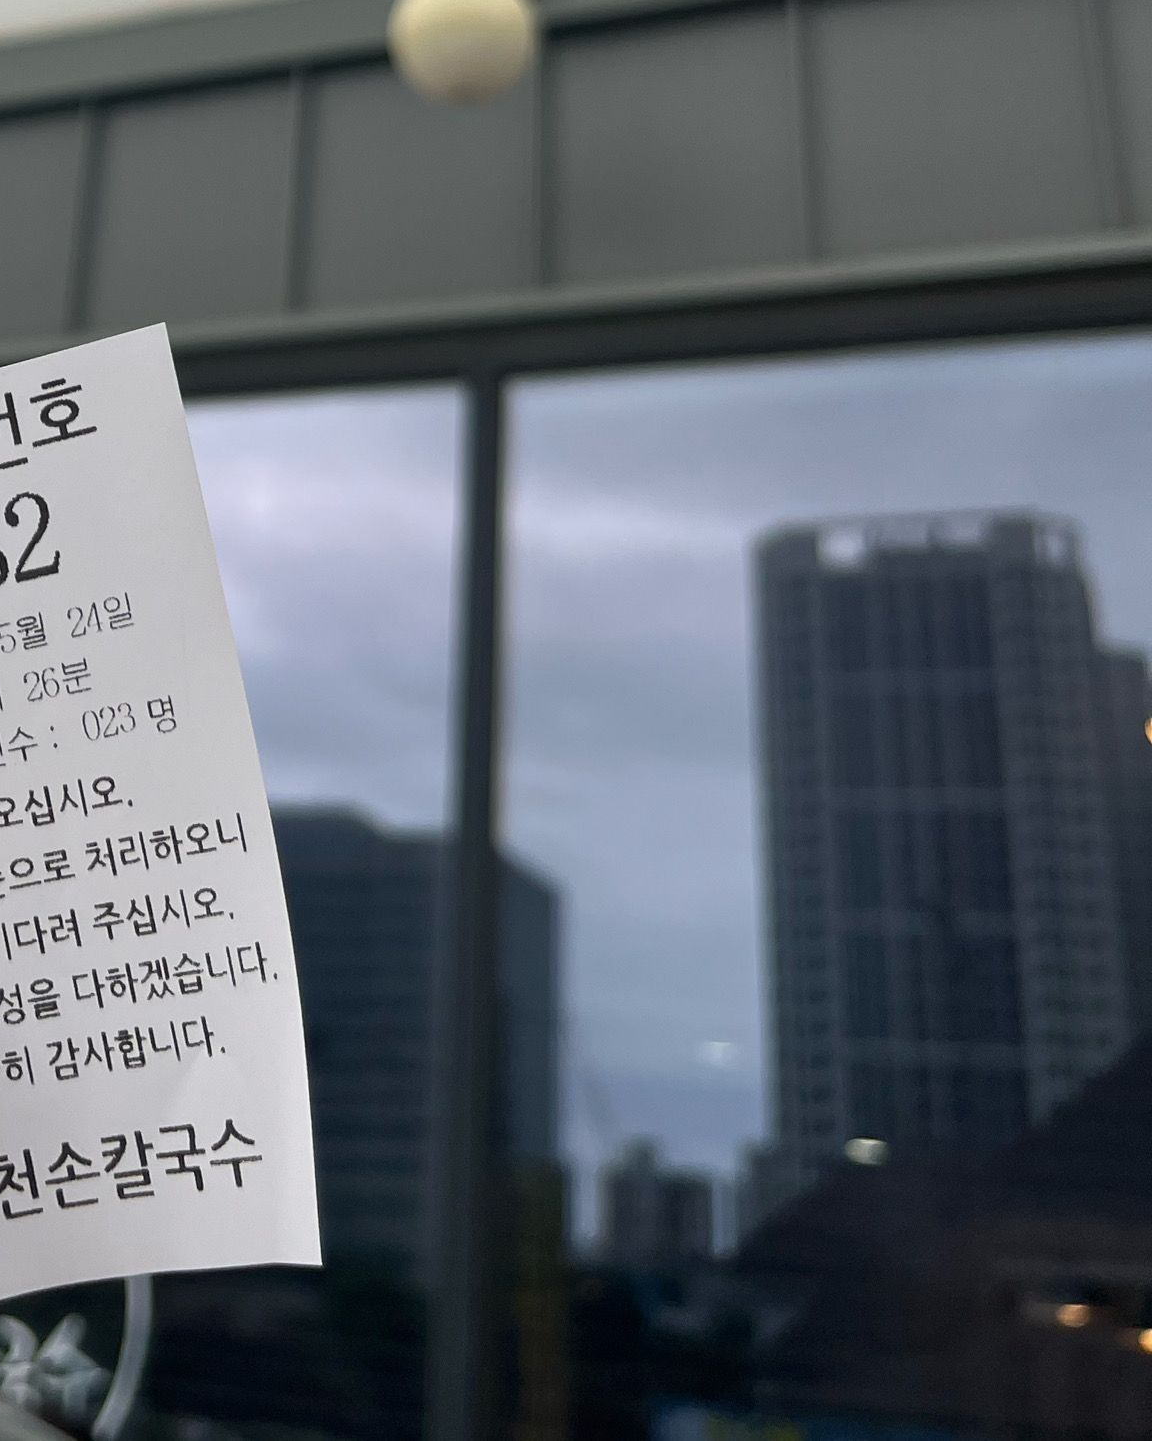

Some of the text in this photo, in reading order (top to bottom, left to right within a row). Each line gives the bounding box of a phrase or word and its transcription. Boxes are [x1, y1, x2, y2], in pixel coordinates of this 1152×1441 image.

[66, 592, 135, 638] 24일
[23, 658, 92, 702] 26분
[81, 703, 136, 741] 023
[147, 694, 178, 734] 명
[85, 812, 247, 877] 처리하오니
[92, 887, 234, 942] 주십시오.
[73, 941, 278, 1009] 다하겠습니다.
[47, 1015, 226, 1081] 감사합니다.
